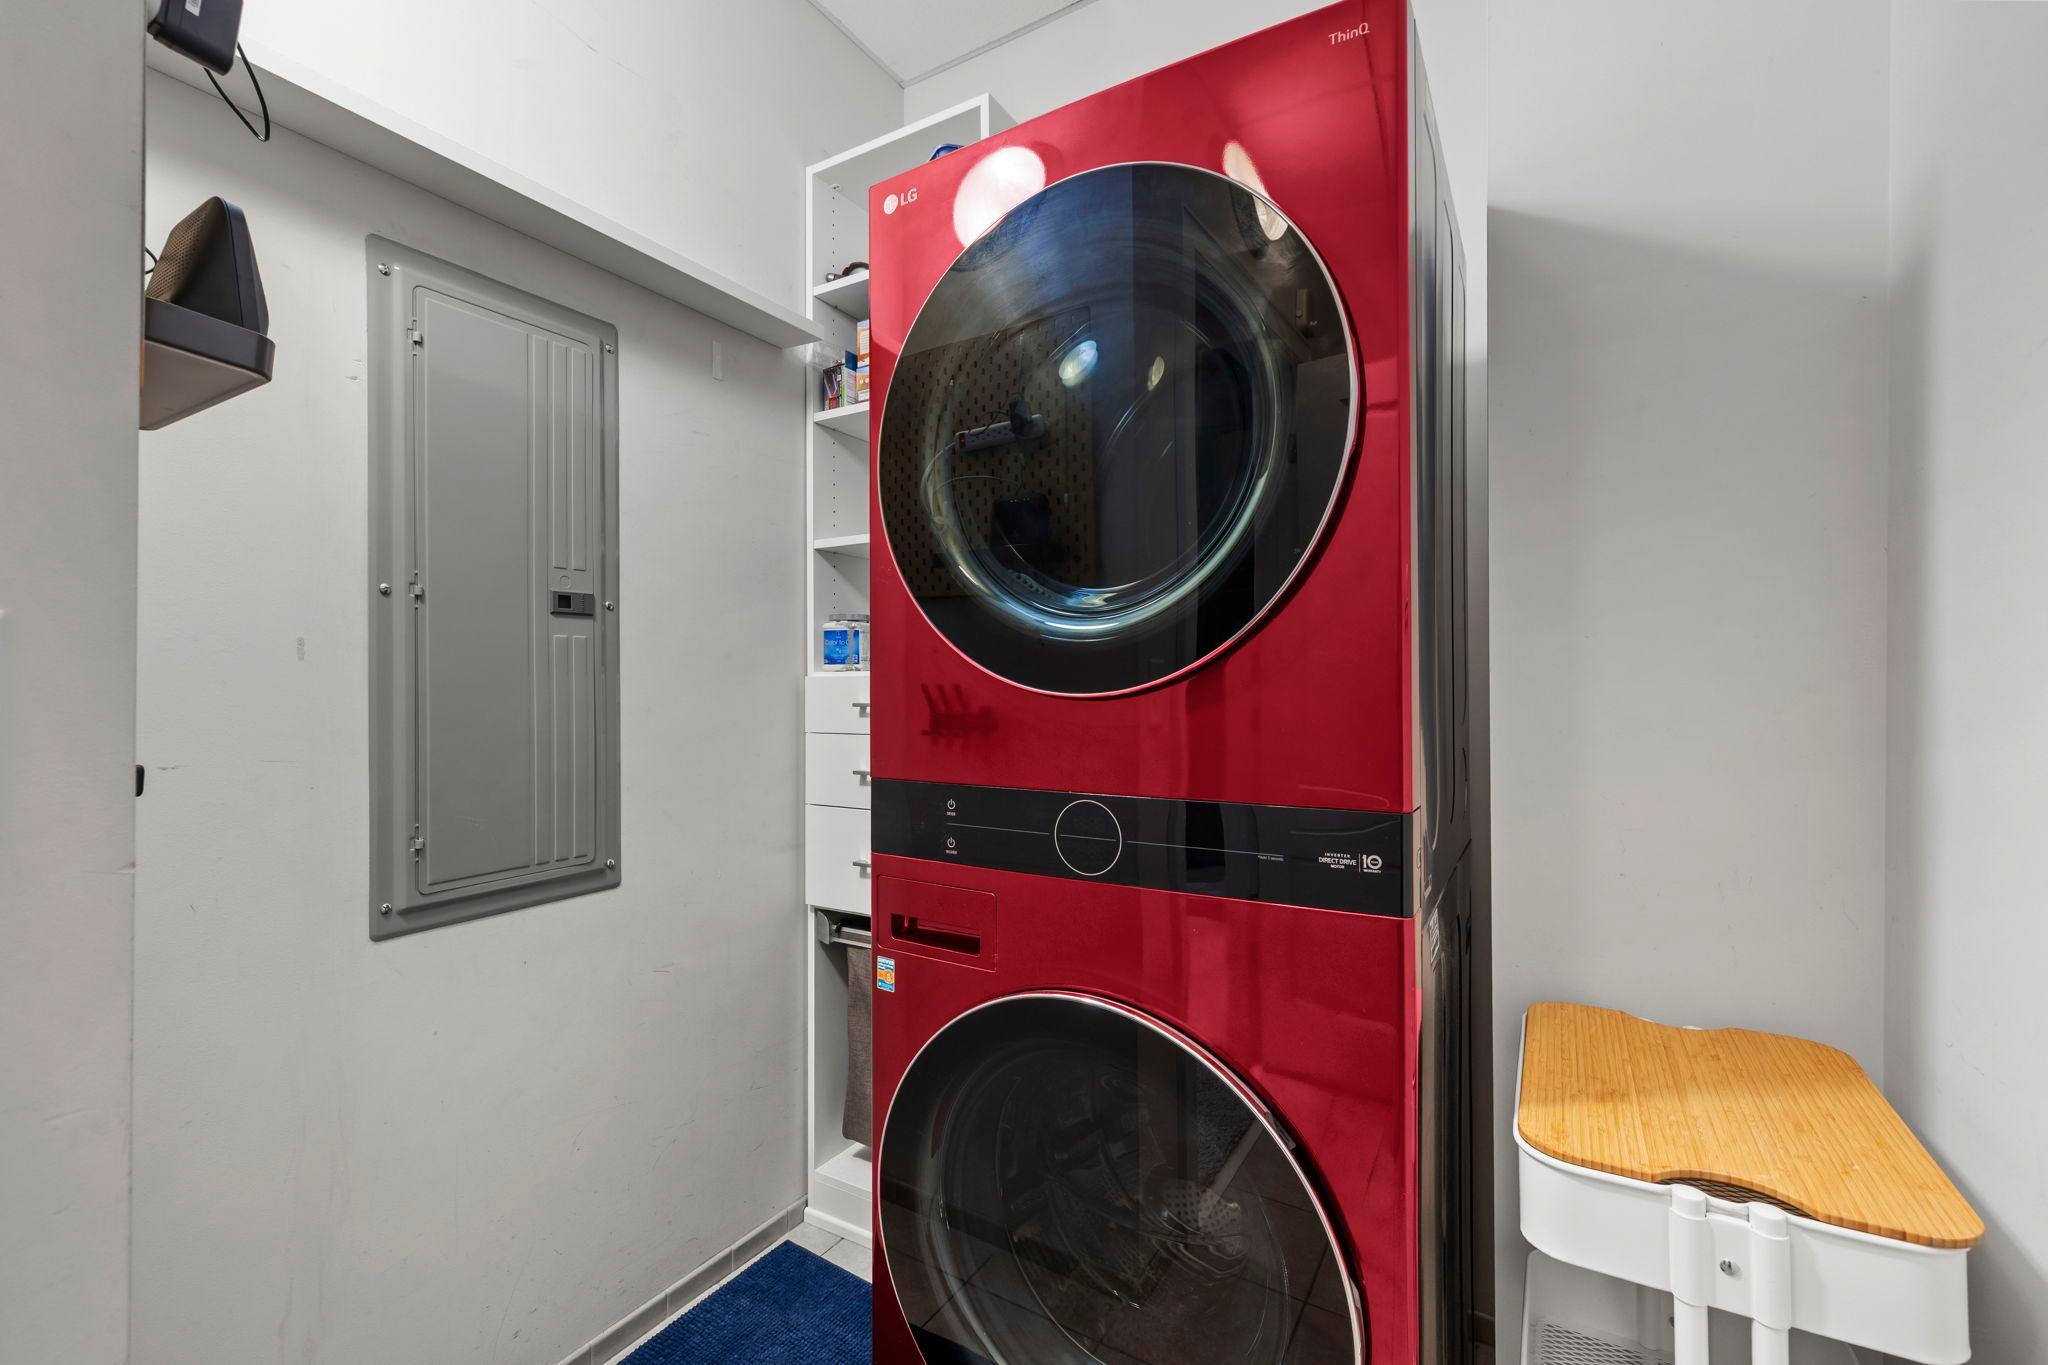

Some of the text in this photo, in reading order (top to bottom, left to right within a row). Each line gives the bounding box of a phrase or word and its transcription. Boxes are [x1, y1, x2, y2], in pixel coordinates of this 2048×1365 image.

[1328, 22, 1370, 45] ThinQ
[900, 188, 917, 206] LG
[1318, 856, 1357, 866] DIRECT DRIVE
[1362, 854, 1382, 870] 10
